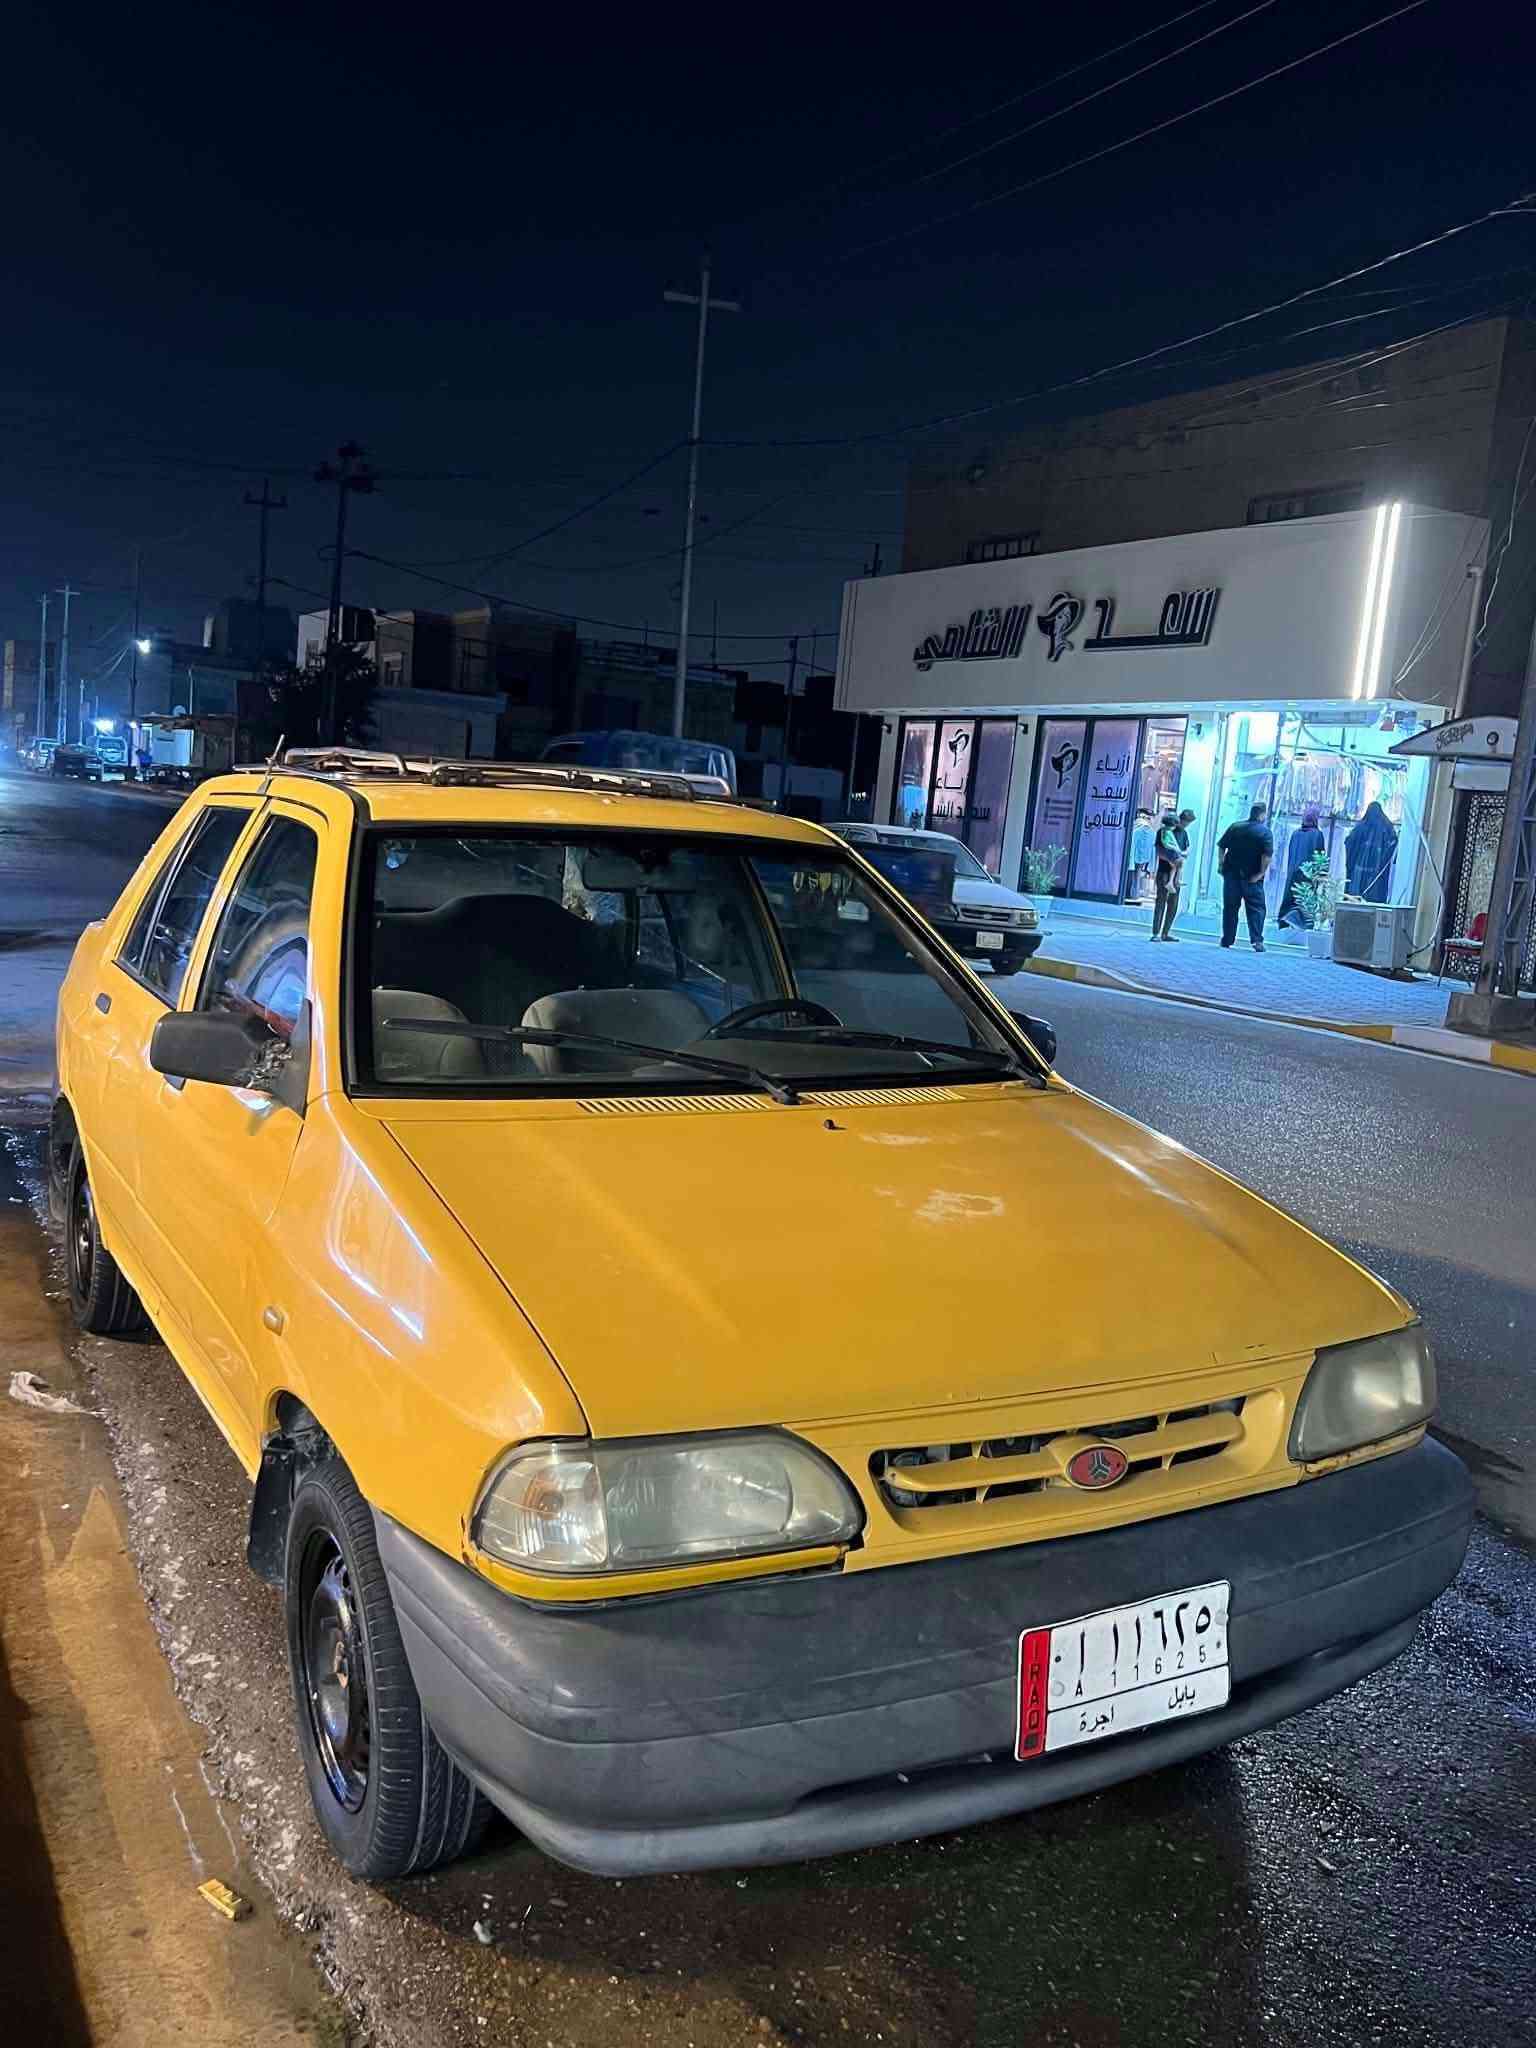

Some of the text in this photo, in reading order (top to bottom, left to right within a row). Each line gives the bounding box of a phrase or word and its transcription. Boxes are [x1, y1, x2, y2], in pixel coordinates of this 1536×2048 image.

[912, 588, 1218, 672] سعد الشامي
[1091, 786, 1127, 800] سعد
[1028, 1640, 1041, 1730] IRAQ
[1168, 1684, 1196, 1710] بابل
